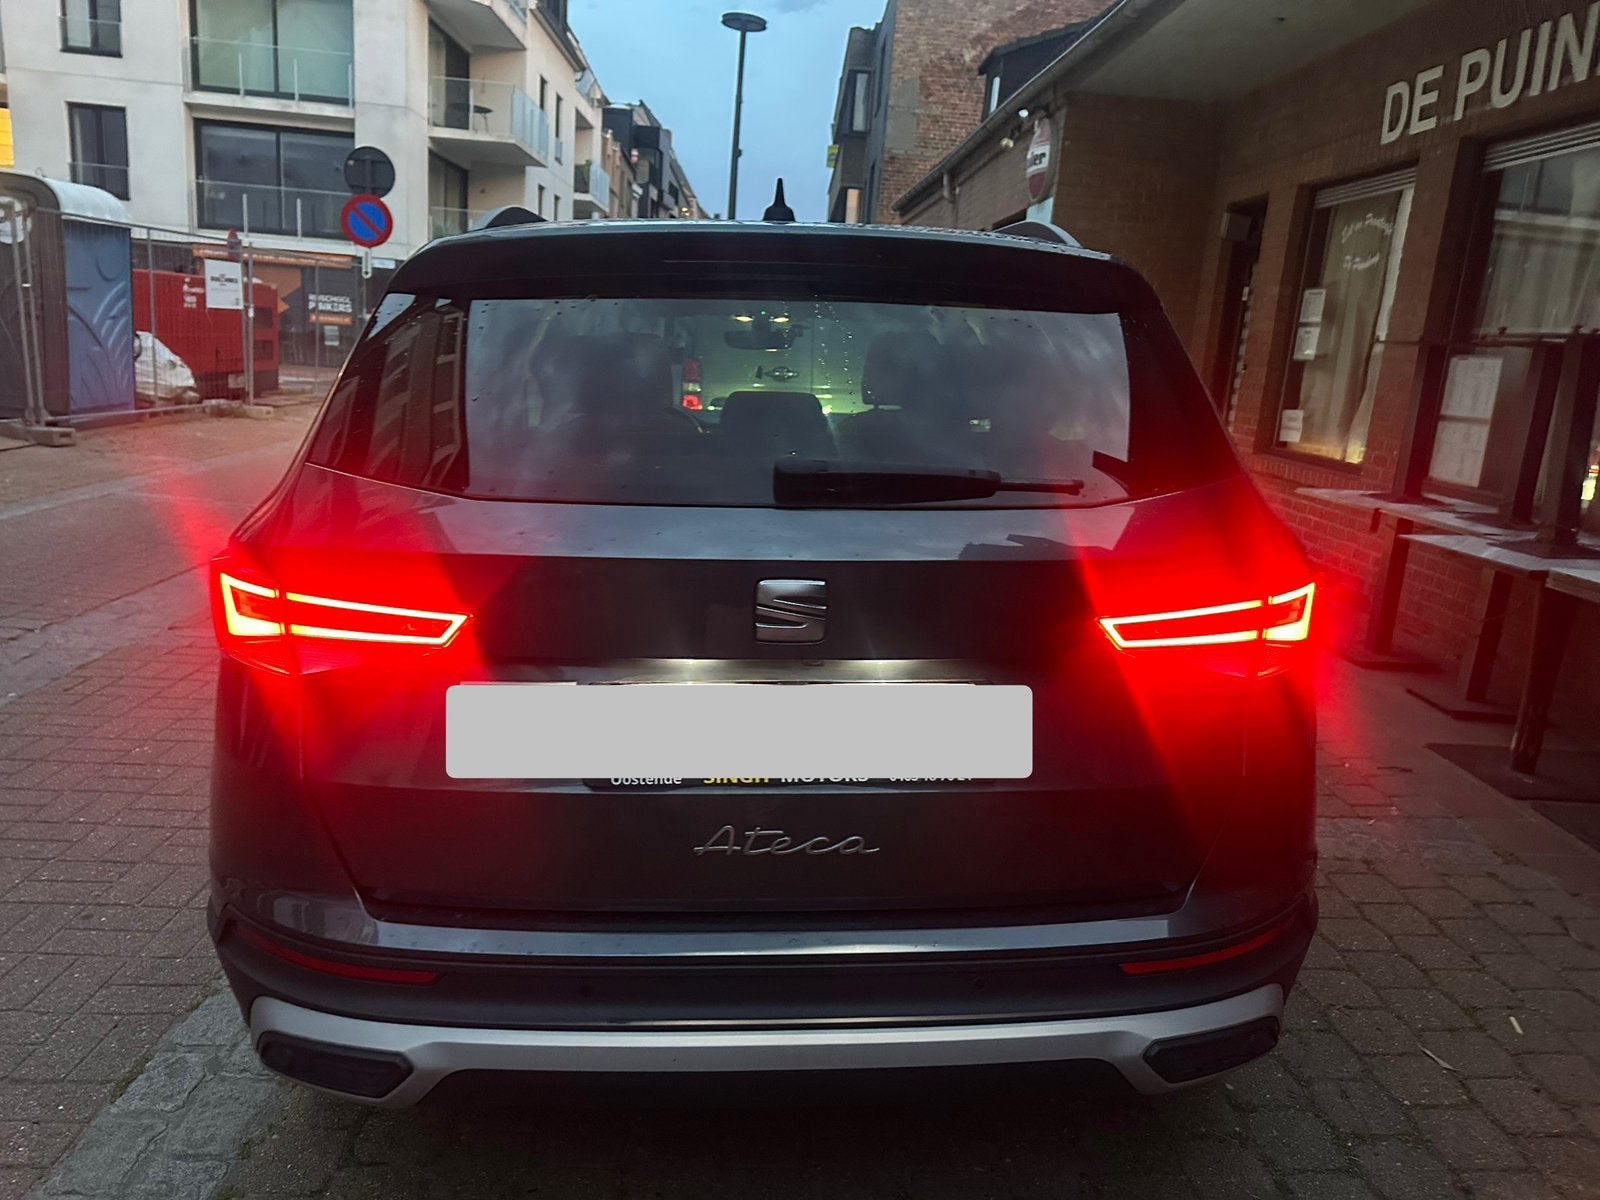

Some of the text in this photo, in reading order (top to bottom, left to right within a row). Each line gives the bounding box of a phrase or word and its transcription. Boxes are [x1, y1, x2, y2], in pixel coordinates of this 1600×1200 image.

[1379, 0, 1600, 145] DE PUIN
[308, 301, 353, 313] PNKERS
[693, 825, 880, 855] Ateca
